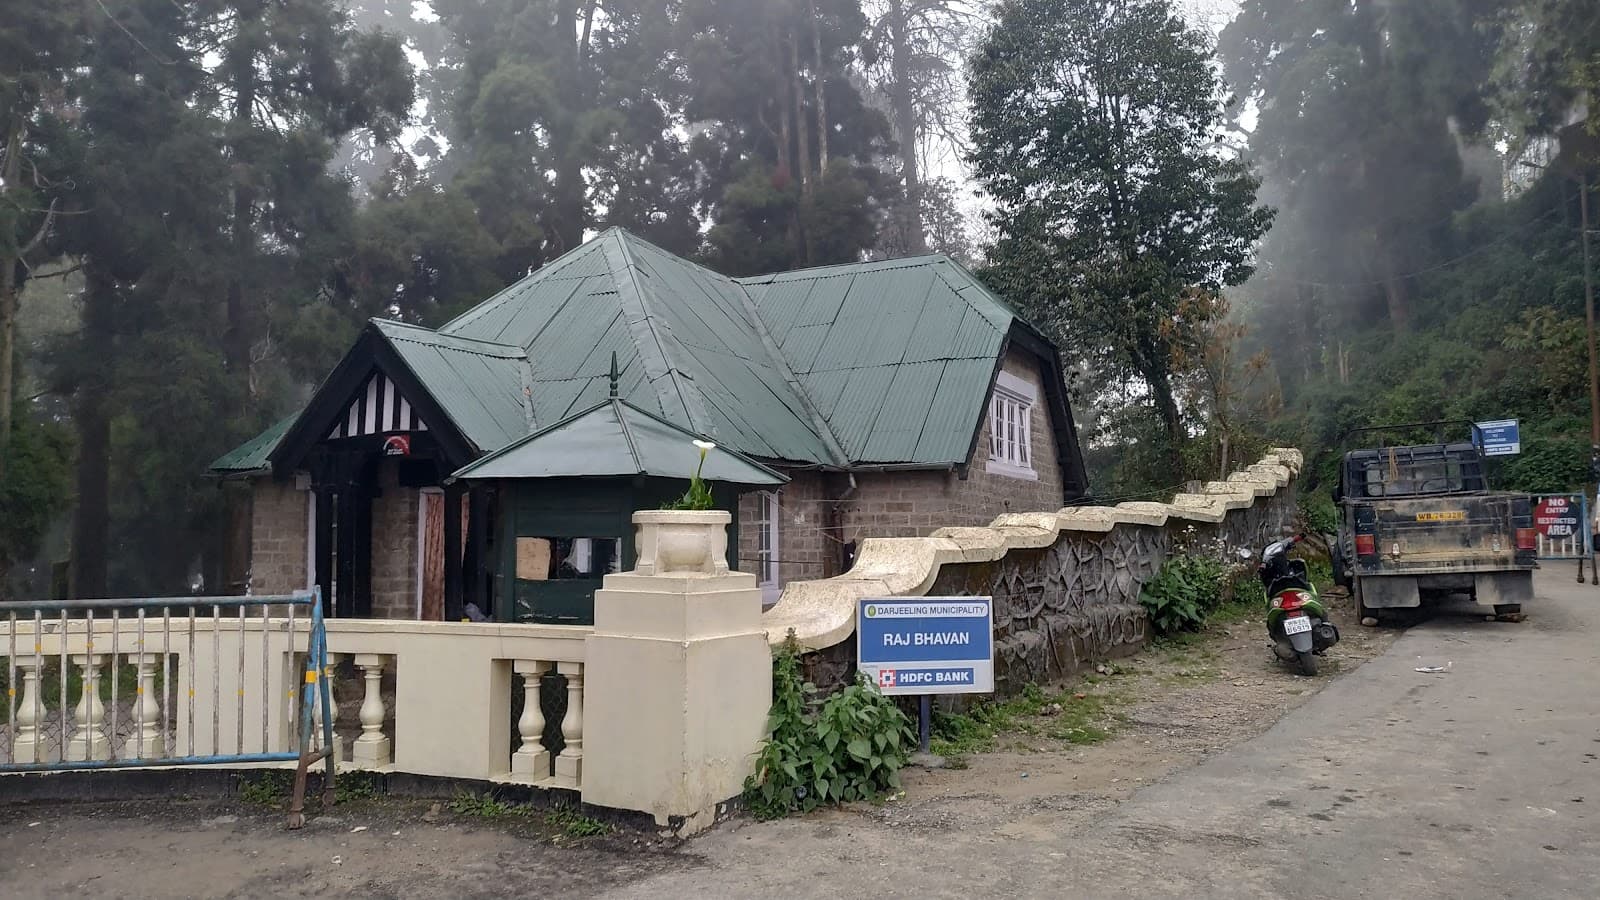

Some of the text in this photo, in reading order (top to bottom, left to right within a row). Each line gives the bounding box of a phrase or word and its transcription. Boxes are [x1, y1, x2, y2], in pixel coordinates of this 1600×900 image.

[1548, 498, 1565, 506] NO
[1537, 517, 1577, 525] RESTRICTED
[1547, 525, 1573, 535] AREA
[877, 605, 985, 615] DARJEELING MUNICIPALITY
[883, 631, 969, 646] RAJ BHAVAN
[899, 671, 969, 683] HDFC BANK
